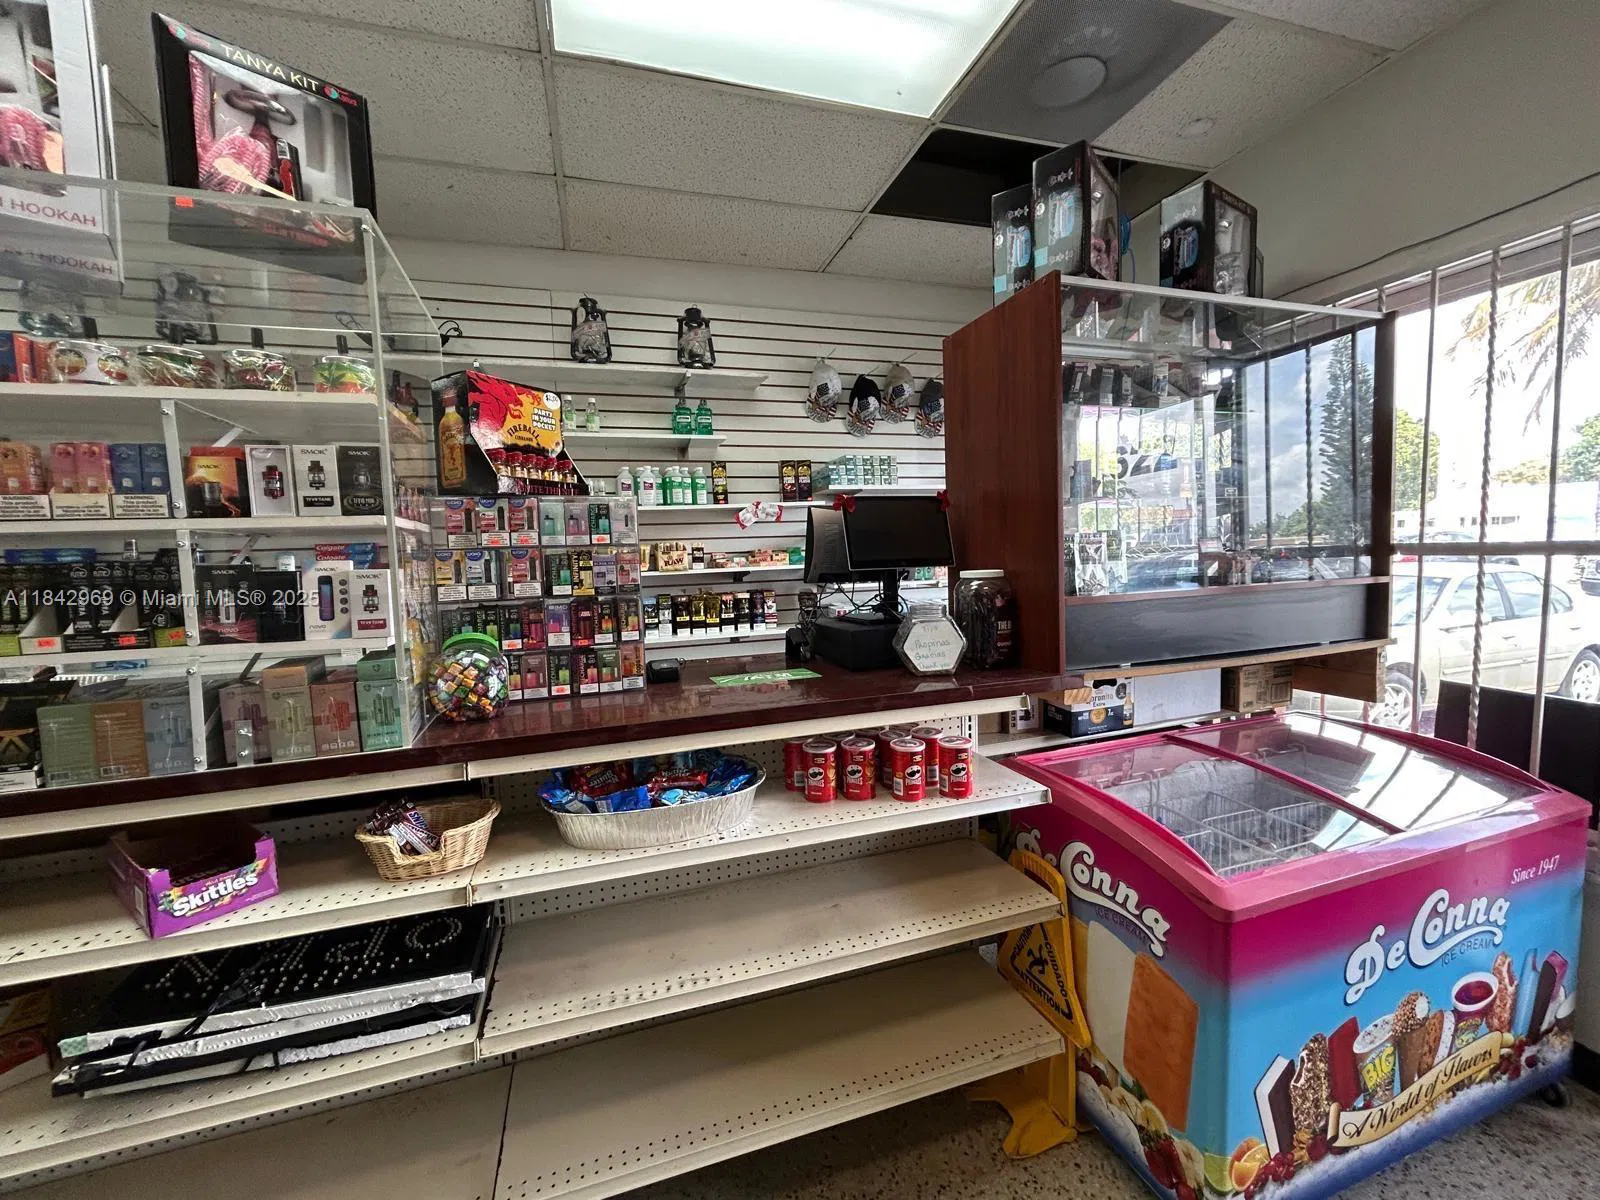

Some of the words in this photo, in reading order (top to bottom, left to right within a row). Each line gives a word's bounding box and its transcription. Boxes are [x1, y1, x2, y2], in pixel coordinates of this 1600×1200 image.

[220, 43, 287, 80] TANYA
[290, 71, 319, 92] KIT
[10, 199, 97, 227] HOOKAH
[507, 423, 541, 440] FIREBALL
[664, 558, 684, 567] RAW
[1511, 867, 1536, 885] Since
[1537, 854, 1560, 876] 1947
[172, 872, 258, 918] Skittles
[1045, 941, 1067, 997] CUIDADO
[1441, 950, 1457, 968] ICE
[1459, 937, 1494, 958] CREAM
[1020, 971, 1062, 1015] ATTENTION
[1361, 1046, 1397, 1093] BIG
[1342, 1111, 1373, 1139] A
[1370, 1086, 1422, 1132] World
[1424, 1069, 1442, 1098] of
[1442, 1049, 1493, 1085] Flavors
